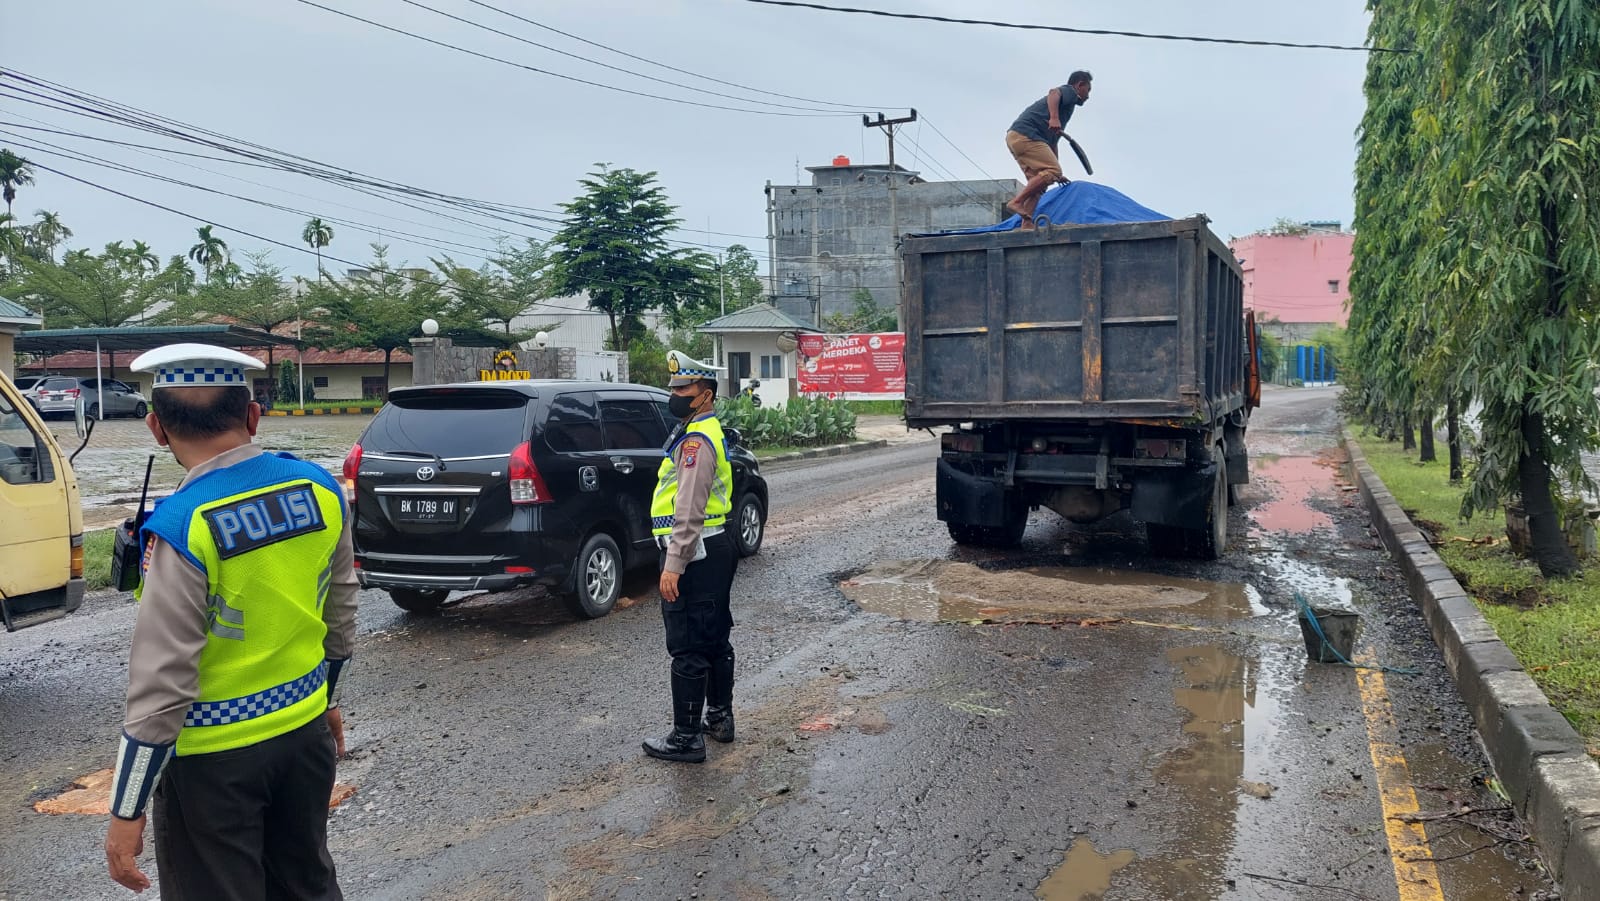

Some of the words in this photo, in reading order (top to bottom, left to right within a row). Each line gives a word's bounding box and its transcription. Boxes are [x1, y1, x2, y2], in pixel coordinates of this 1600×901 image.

[830, 337, 860, 349] PAKET
[823, 345, 867, 359] MERDEKA
[401, 500, 411, 513] BK
[416, 500, 437, 513] 1789
[443, 501, 454, 513] QV
[212, 489, 321, 550] POLISI
